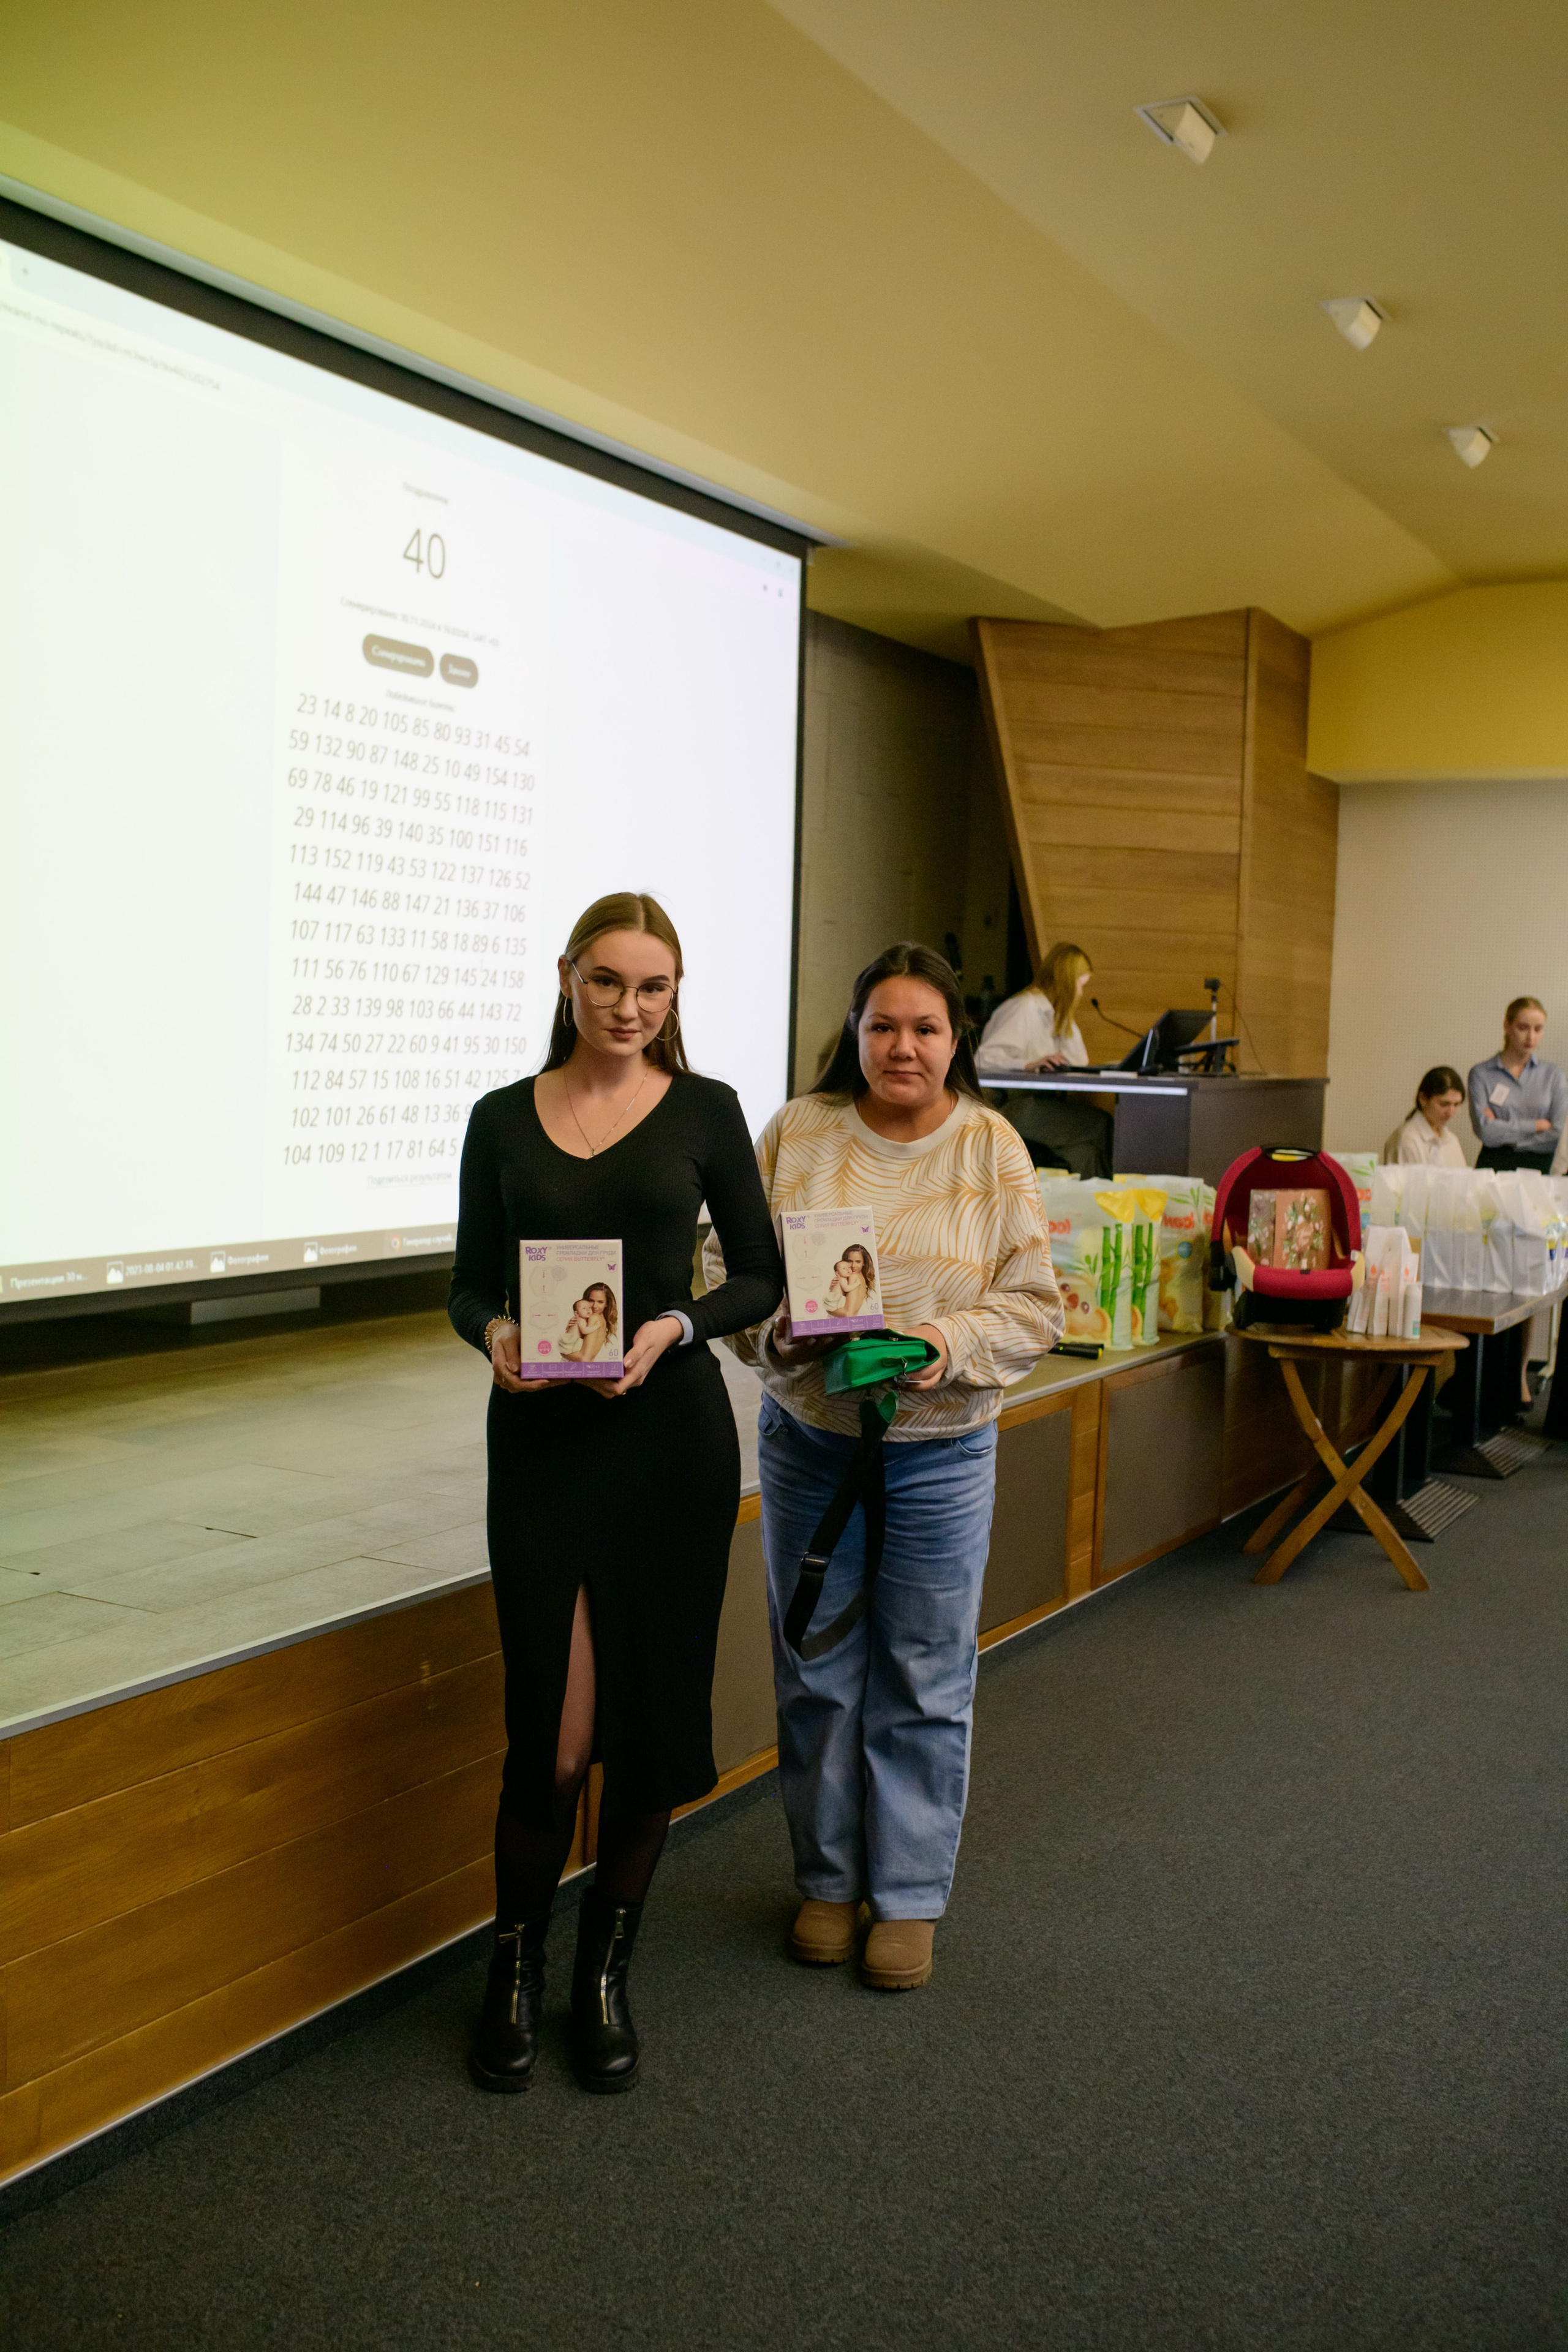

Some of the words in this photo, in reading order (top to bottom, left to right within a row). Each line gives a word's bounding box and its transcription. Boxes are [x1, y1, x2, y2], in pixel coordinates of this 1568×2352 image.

[402, 528, 447, 580] 40
[296, 693, 317, 715] 23
[325, 698, 341, 718] 14
[345, 703, 355, 722] 8
[358, 706, 378, 727] 20
[384, 711, 408, 734] 105
[412, 717, 429, 737] 85
[434, 722, 451, 742] 80
[455, 726, 472, 746] 93
[475, 730, 491, 750] 31
[494, 735, 510, 754] 45
[514, 739, 530, 758] 54
[289, 729, 309, 751] 59
[316, 734, 342, 757] 132
[347, 740, 366, 761] 90
[369, 744, 388, 764] 87
[394, 750, 418, 770] 148
[422, 755, 439, 775] 25
[445, 759, 460, 778] 10
[464, 763, 480, 782] 49
[486, 766, 508, 788] 154
[513, 771, 535, 793] 130
[288, 767, 308, 788] 69
[314, 771, 332, 793] 78
[336, 776, 355, 796] 46
[362, 779, 379, 799] 19
[385, 783, 407, 804] 121
[413, 788, 431, 809] 99
[435, 791, 450, 812] 55
[458, 795, 479, 816] 118
[486, 800, 507, 821] 115
[513, 805, 533, 824] 131
[293, 806, 314, 827] 29
[322, 810, 347, 831] 114
[352, 815, 370, 835] 96
[375, 818, 393, 838] 39
[399, 821, 423, 843] 140
[426, 826, 443, 846] 35
[450, 829, 473, 850] 100
[478, 833, 499, 852] 151
[506, 837, 527, 857] 116
[291, 843, 318, 865] 113
[325, 848, 352, 869] 152
[358, 852, 383, 873] 119
[387, 856, 405, 875] 43
[409, 858, 426, 878] 53
[432, 861, 456, 882] 122
[462, 865, 484, 884] 137
[490, 869, 511, 888] 126
[515, 871, 530, 891] 52
[295, 882, 322, 903] 144
[326, 885, 346, 905] 47
[353, 888, 377, 908] 146
[382, 891, 400, 911] 88
[406, 894, 431, 912] 147
[433, 896, 450, 915] 21
[457, 899, 479, 918] 136
[483, 901, 500, 919] 37
[504, 903, 525, 923] 106
[292, 919, 320, 940] 107
[326, 922, 352, 943] 117
[356, 924, 375, 944] 63
[382, 927, 406, 947] 133
[412, 929, 426, 948] 11
[431, 930, 448, 950] 58
[454, 933, 469, 952] 18
[472, 934, 489, 953] 89
[492, 936, 500, 954] 6
[505, 937, 527, 956] 135
[293, 957, 319, 978] 111
[325, 959, 344, 979] 56
[349, 960, 366, 981] 76
[374, 962, 399, 982] 110
[402, 963, 420, 982] 67
[426, 965, 450, 985] 129
[455, 967, 477, 986] 145
[481, 968, 497, 987] 24
[503, 970, 525, 989] 158
[292, 995, 313, 1015] 28
[316, 995, 327, 1016] 2
[331, 996, 350, 1016] 33
[357, 997, 382, 1017] 139
[386, 998, 404, 1017] 98
[410, 1000, 434, 1019] 103
[438, 1001, 454, 1019] 66
[458, 1001, 475, 1019] 44
[480, 1002, 502, 1021] 143
[507, 1003, 522, 1022] 72
[287, 1032, 314, 1052] 134
[320, 1032, 337, 1052] 74
[344, 1032, 361, 1053] 50
[364, 1033, 384, 1053] 27
[386, 1033, 406, 1054] 22
[409, 1035, 427, 1053] 60
[431, 1035, 439, 1054] 9
[443, 1036, 459, 1053] 41
[464, 1035, 480, 1054] 95
[483, 1036, 500, 1054] 30
[505, 1036, 527, 1055] 150
[293, 1070, 320, 1090] 112
[325, 1069, 344, 1090] 84
[349, 1069, 368, 1089] 57
[373, 1069, 389, 1090] 15
[395, 1069, 420, 1089] 108
[426, 1069, 440, 1088] 16
[444, 1069, 460, 1088] 51
[465, 1069, 481, 1088] 42
[486, 1068, 508, 1088] 125
[293, 1107, 320, 1128] 102
[326, 1106, 351, 1126] 101
[356, 1106, 375, 1126] 26
[379, 1105, 396, 1125] 61
[401, 1105, 419, 1123] 48
[425, 1104, 440, 1123] 13
[443, 1104, 460, 1123] 36
[285, 1144, 312, 1165] 104
[318, 1143, 345, 1163] 109
[352, 1142, 368, 1161] 12
[374, 1141, 380, 1160] 1
[388, 1140, 404, 1159] 17
[407, 1139, 423, 1159] 81
[428, 1139, 445, 1158] 64
[449, 1138, 457, 1156] 5
[786, 1215, 806, 1224] ROXY
[525, 1246, 548, 1254] ROXY
